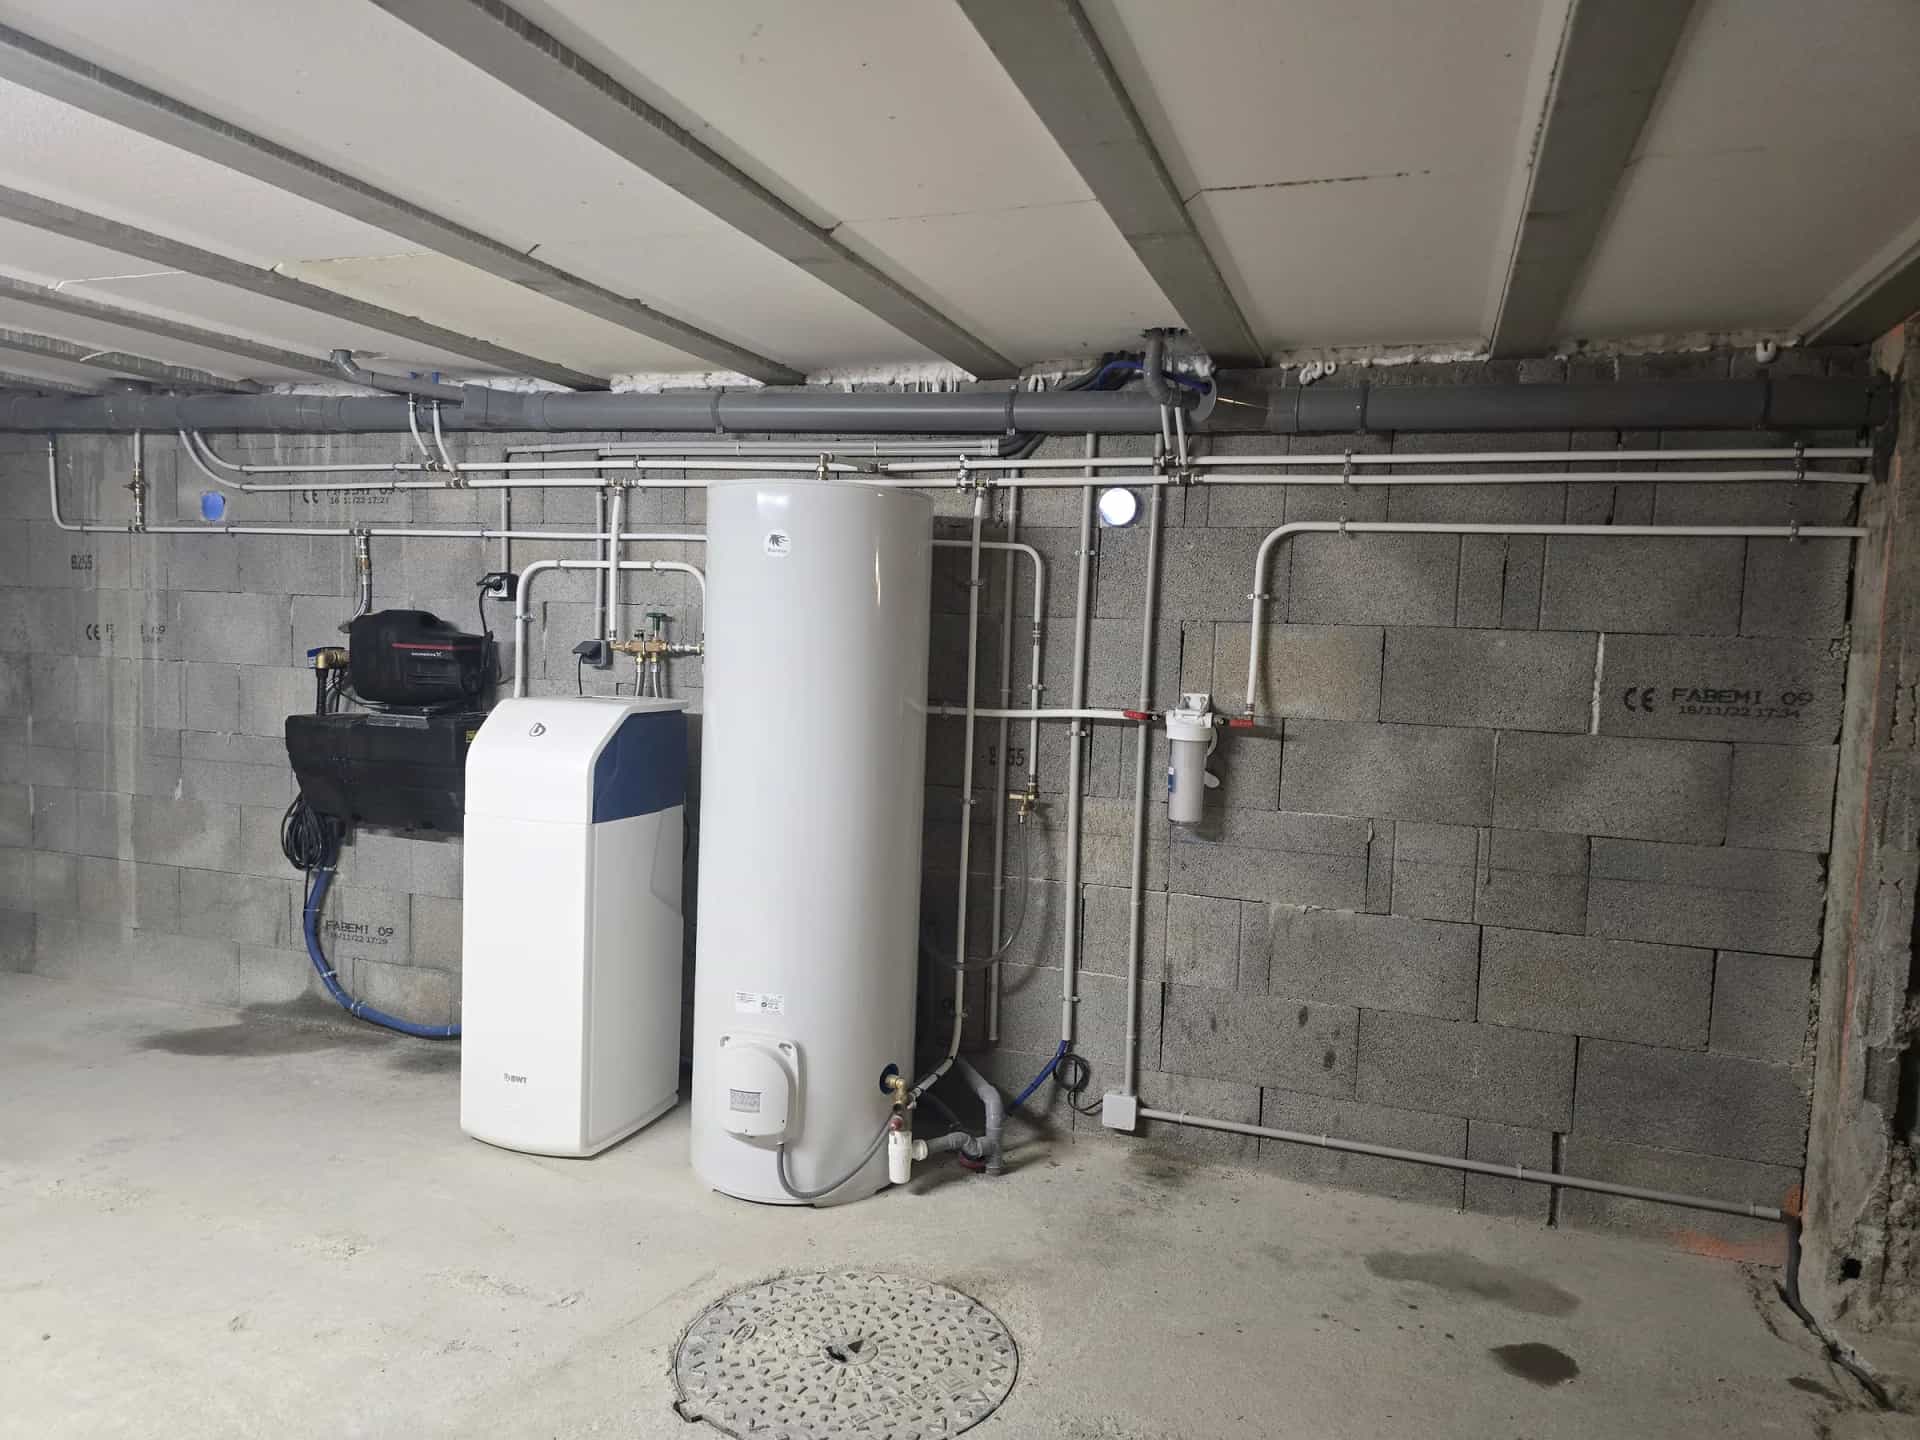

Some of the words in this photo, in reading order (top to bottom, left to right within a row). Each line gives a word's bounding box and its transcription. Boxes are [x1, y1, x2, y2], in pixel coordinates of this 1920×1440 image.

[1624, 686, 1655, 713] CE
[1671, 687, 1763, 705] FABEMI
[325, 920, 369, 935] FABEMI
[378, 926, 394, 937] 09
